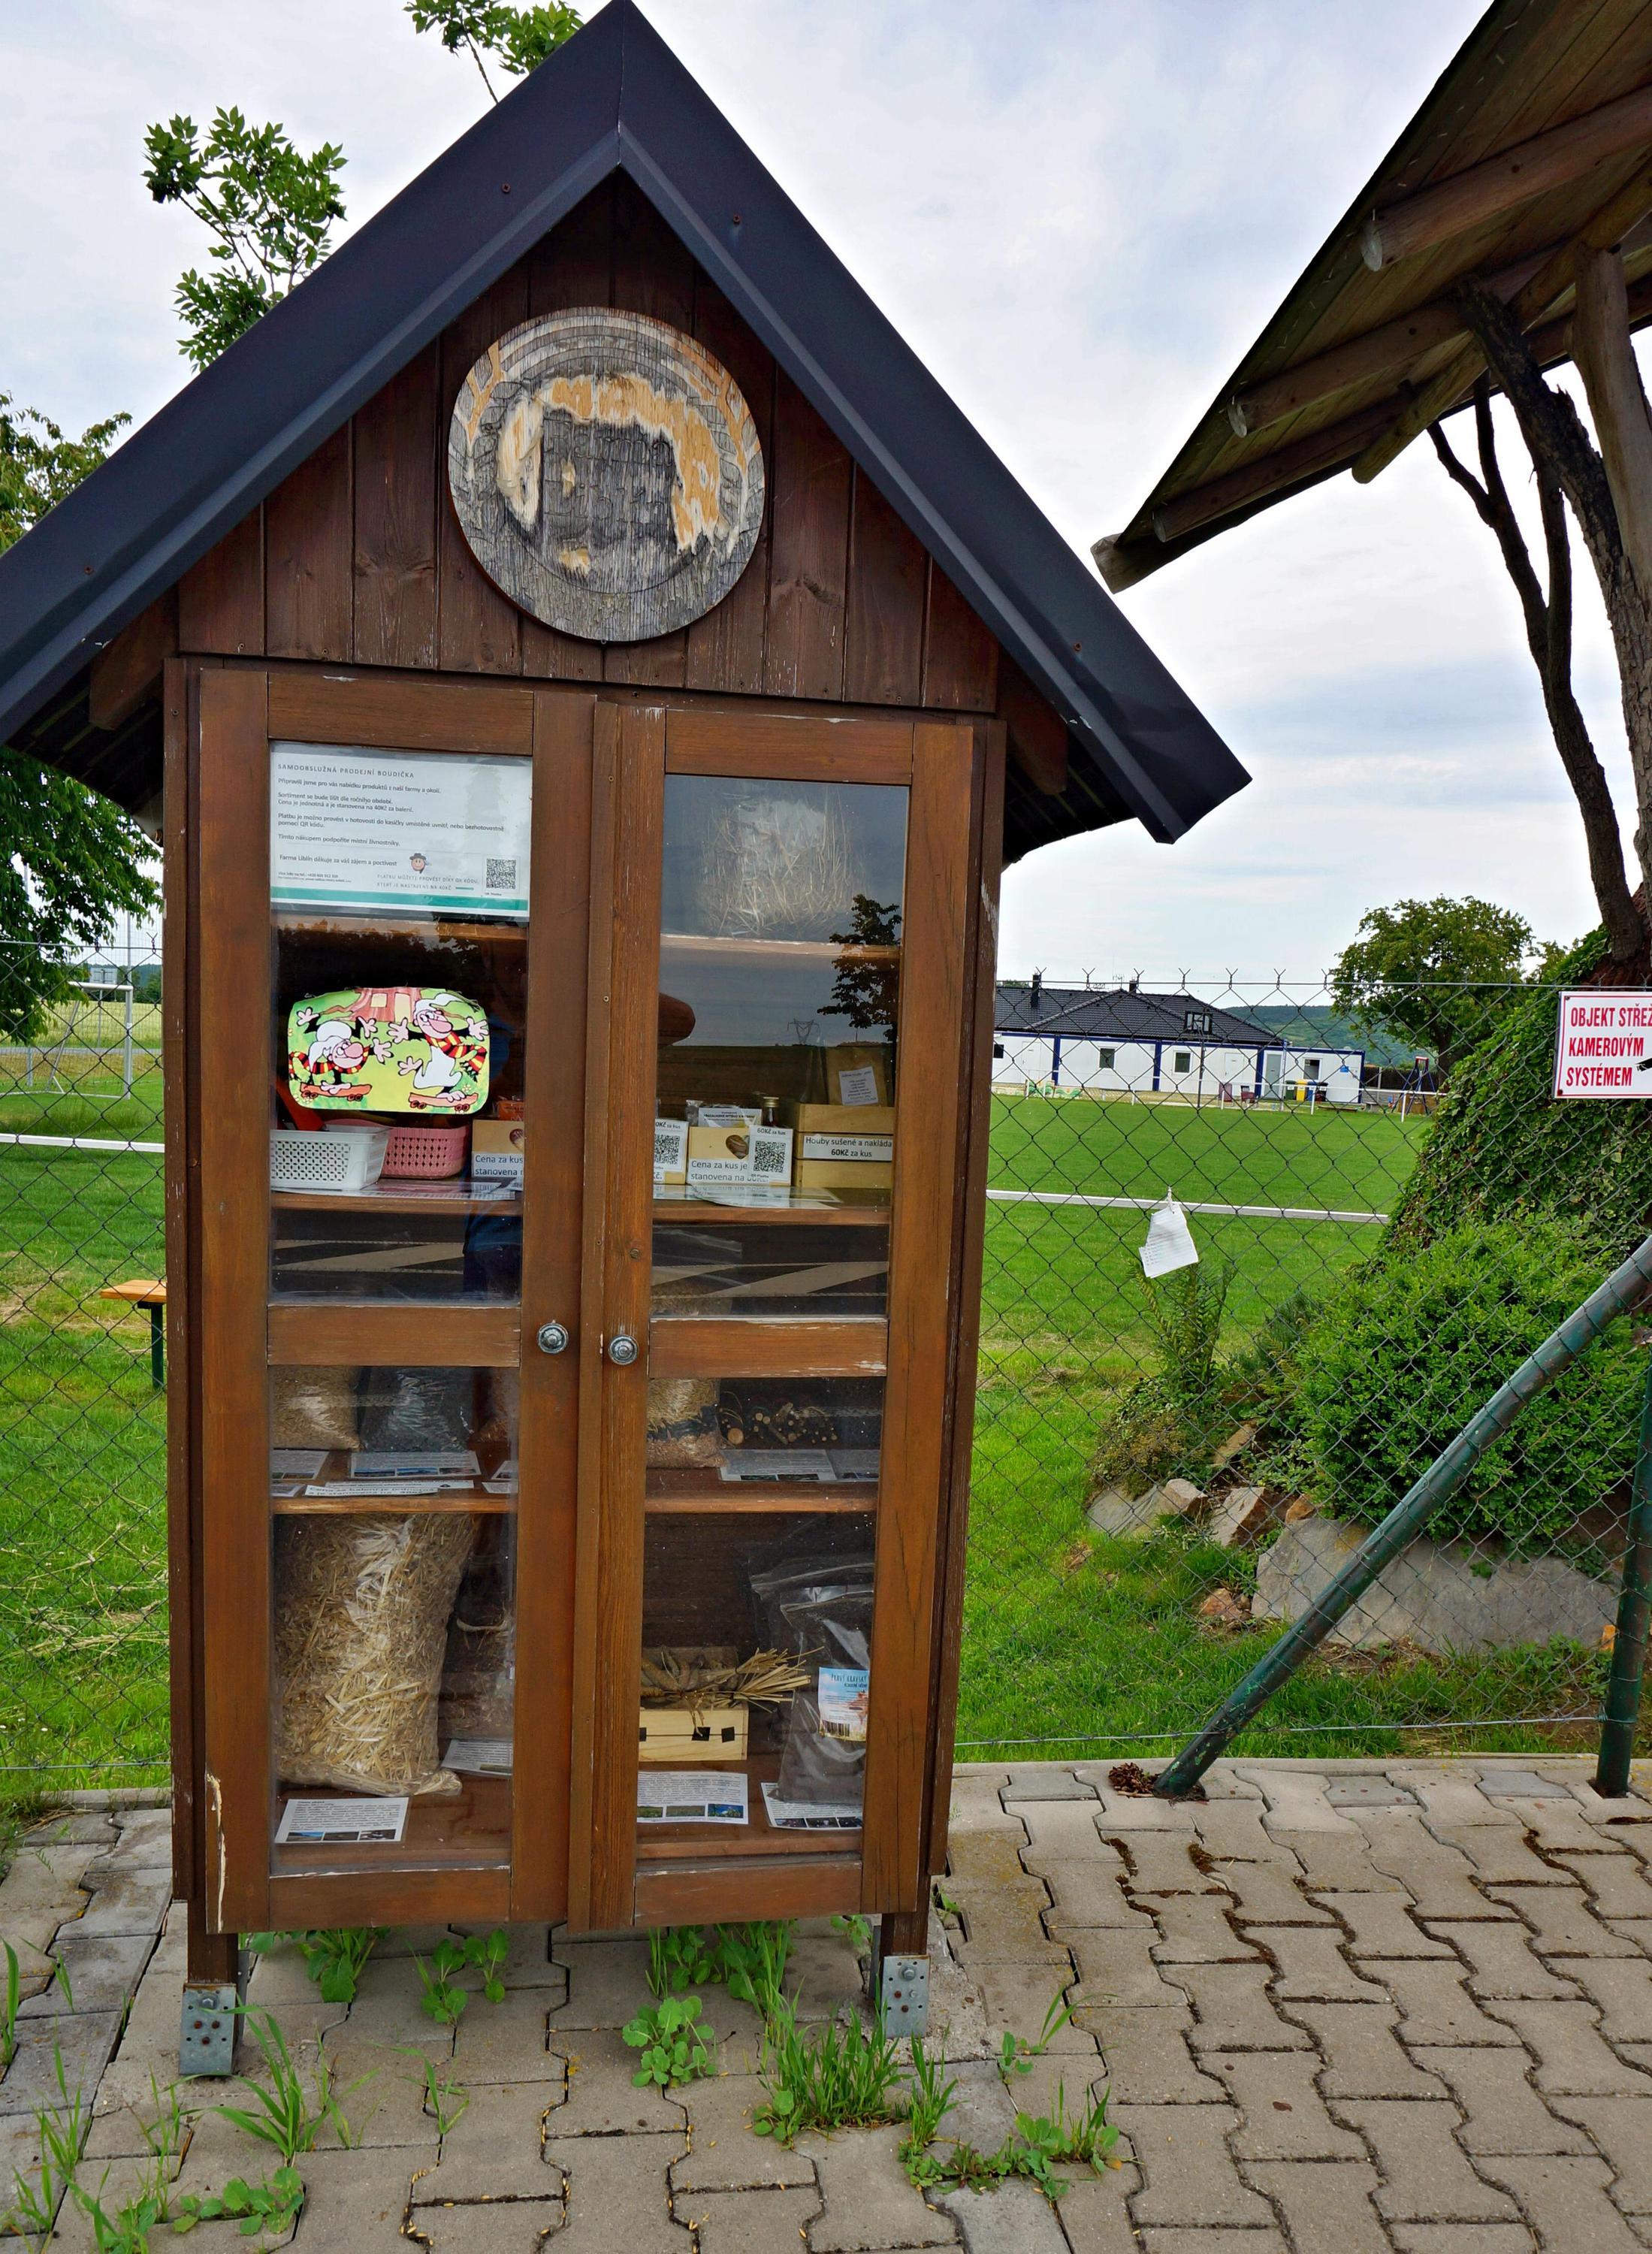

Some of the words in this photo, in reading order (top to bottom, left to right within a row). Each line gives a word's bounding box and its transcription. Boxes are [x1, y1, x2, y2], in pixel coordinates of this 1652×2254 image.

[277, 763, 337, 773] SAMOOBSLUŽNÁ
[340, 767, 374, 775] PRODEJNÍ
[385, 818, 404, 826] kasičky
[1570, 1007, 1615, 1027] OBJEKT
[1618, 1003, 1652, 1027] STŘEŽ
[1568, 1033, 1644, 1057] KAMEROVÝM
[1566, 1062, 1632, 1086] SYSTÉMEM
[805, 1137, 829, 1146] Houby
[831, 1138, 856, 1147] sušené
[831, 1148, 849, 1156] 60Kč
[475, 1155, 496, 1163] Cena
[509, 1156, 524, 1164] kus
[691, 1160, 711, 1168] Cena
[740, 1162, 748, 1171] je
[475, 1168, 518, 1176] stanovena
[690, 1173, 732, 1181] stanovena
